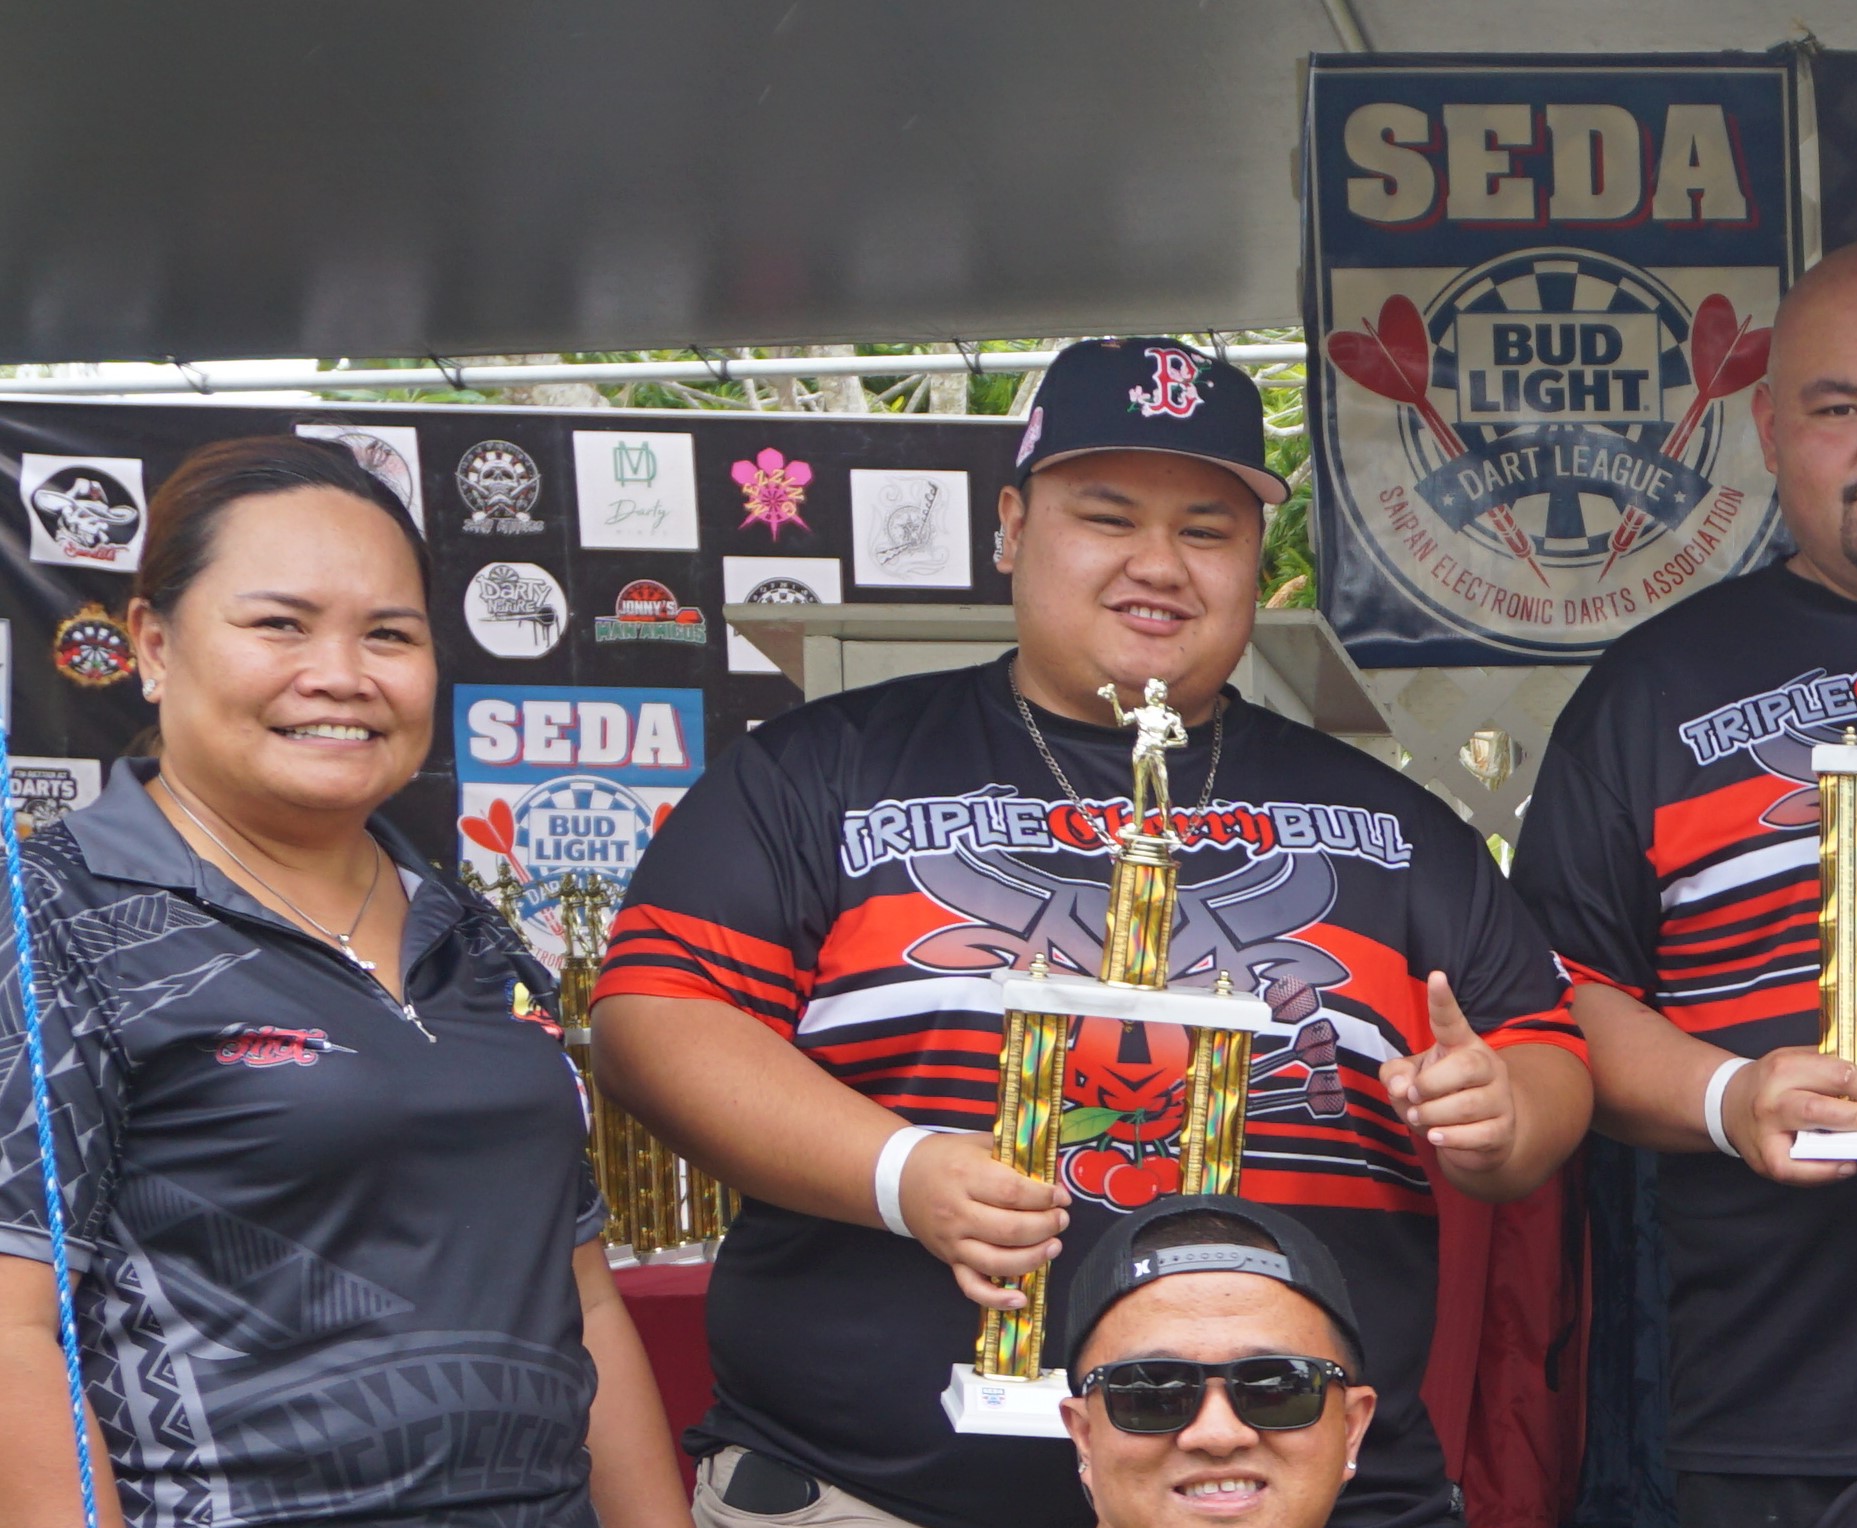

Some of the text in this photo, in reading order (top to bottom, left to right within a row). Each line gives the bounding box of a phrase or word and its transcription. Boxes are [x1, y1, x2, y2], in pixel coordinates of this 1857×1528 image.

[1343, 102, 1755, 229] SEDA
[1493, 323, 1623, 366] BUD
[1470, 369, 1647, 413] LIGHT
[1457, 445, 1674, 501] DART LEAGUE
[1380, 485, 1745, 625] SAIPAN ELECTRONIC DARTS ASSOCIATION
[468, 698, 688, 768] SEDA
[9, 778, 76, 799] DARTS
[549, 815, 617, 838] BUD
[535, 840, 630, 863] LIGHT
